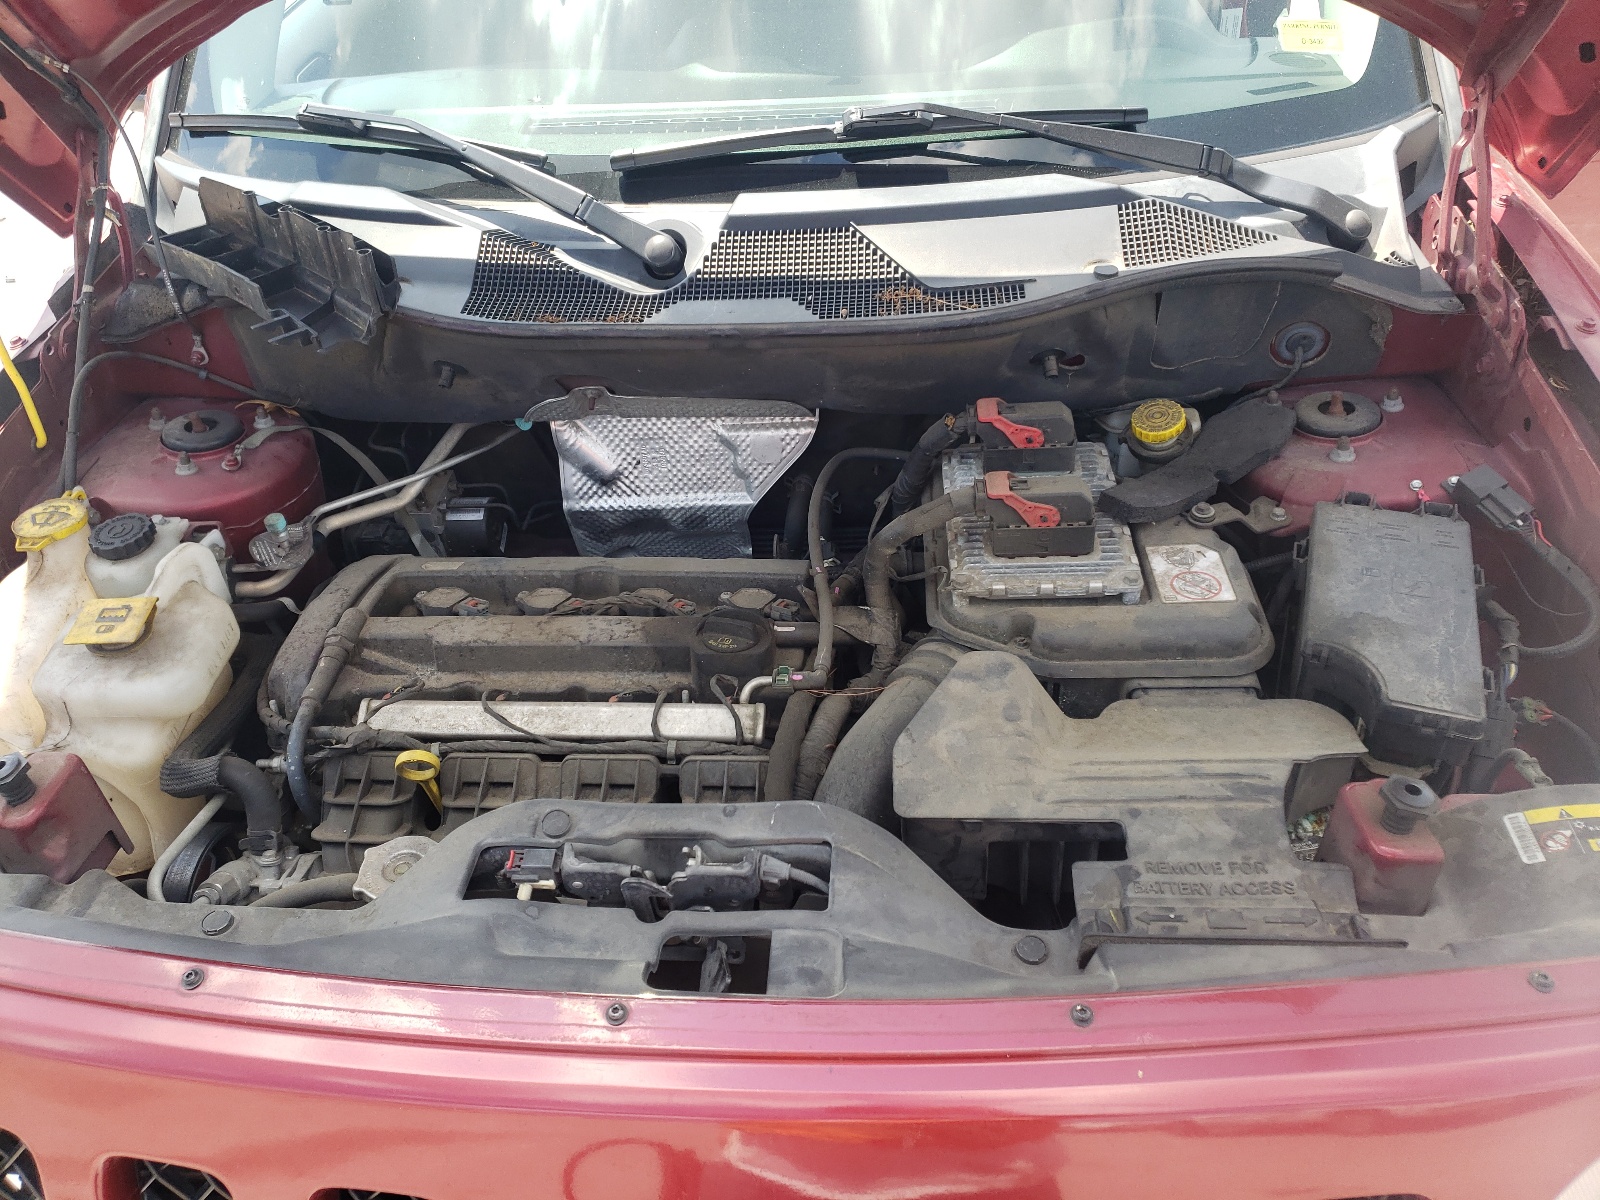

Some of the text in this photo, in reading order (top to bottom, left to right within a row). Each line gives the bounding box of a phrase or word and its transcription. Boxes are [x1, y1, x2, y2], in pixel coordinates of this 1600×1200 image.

[1143, 860, 1268, 876] REMOVE FOR
[1132, 880, 1296, 897] BATTERY ACCESS
